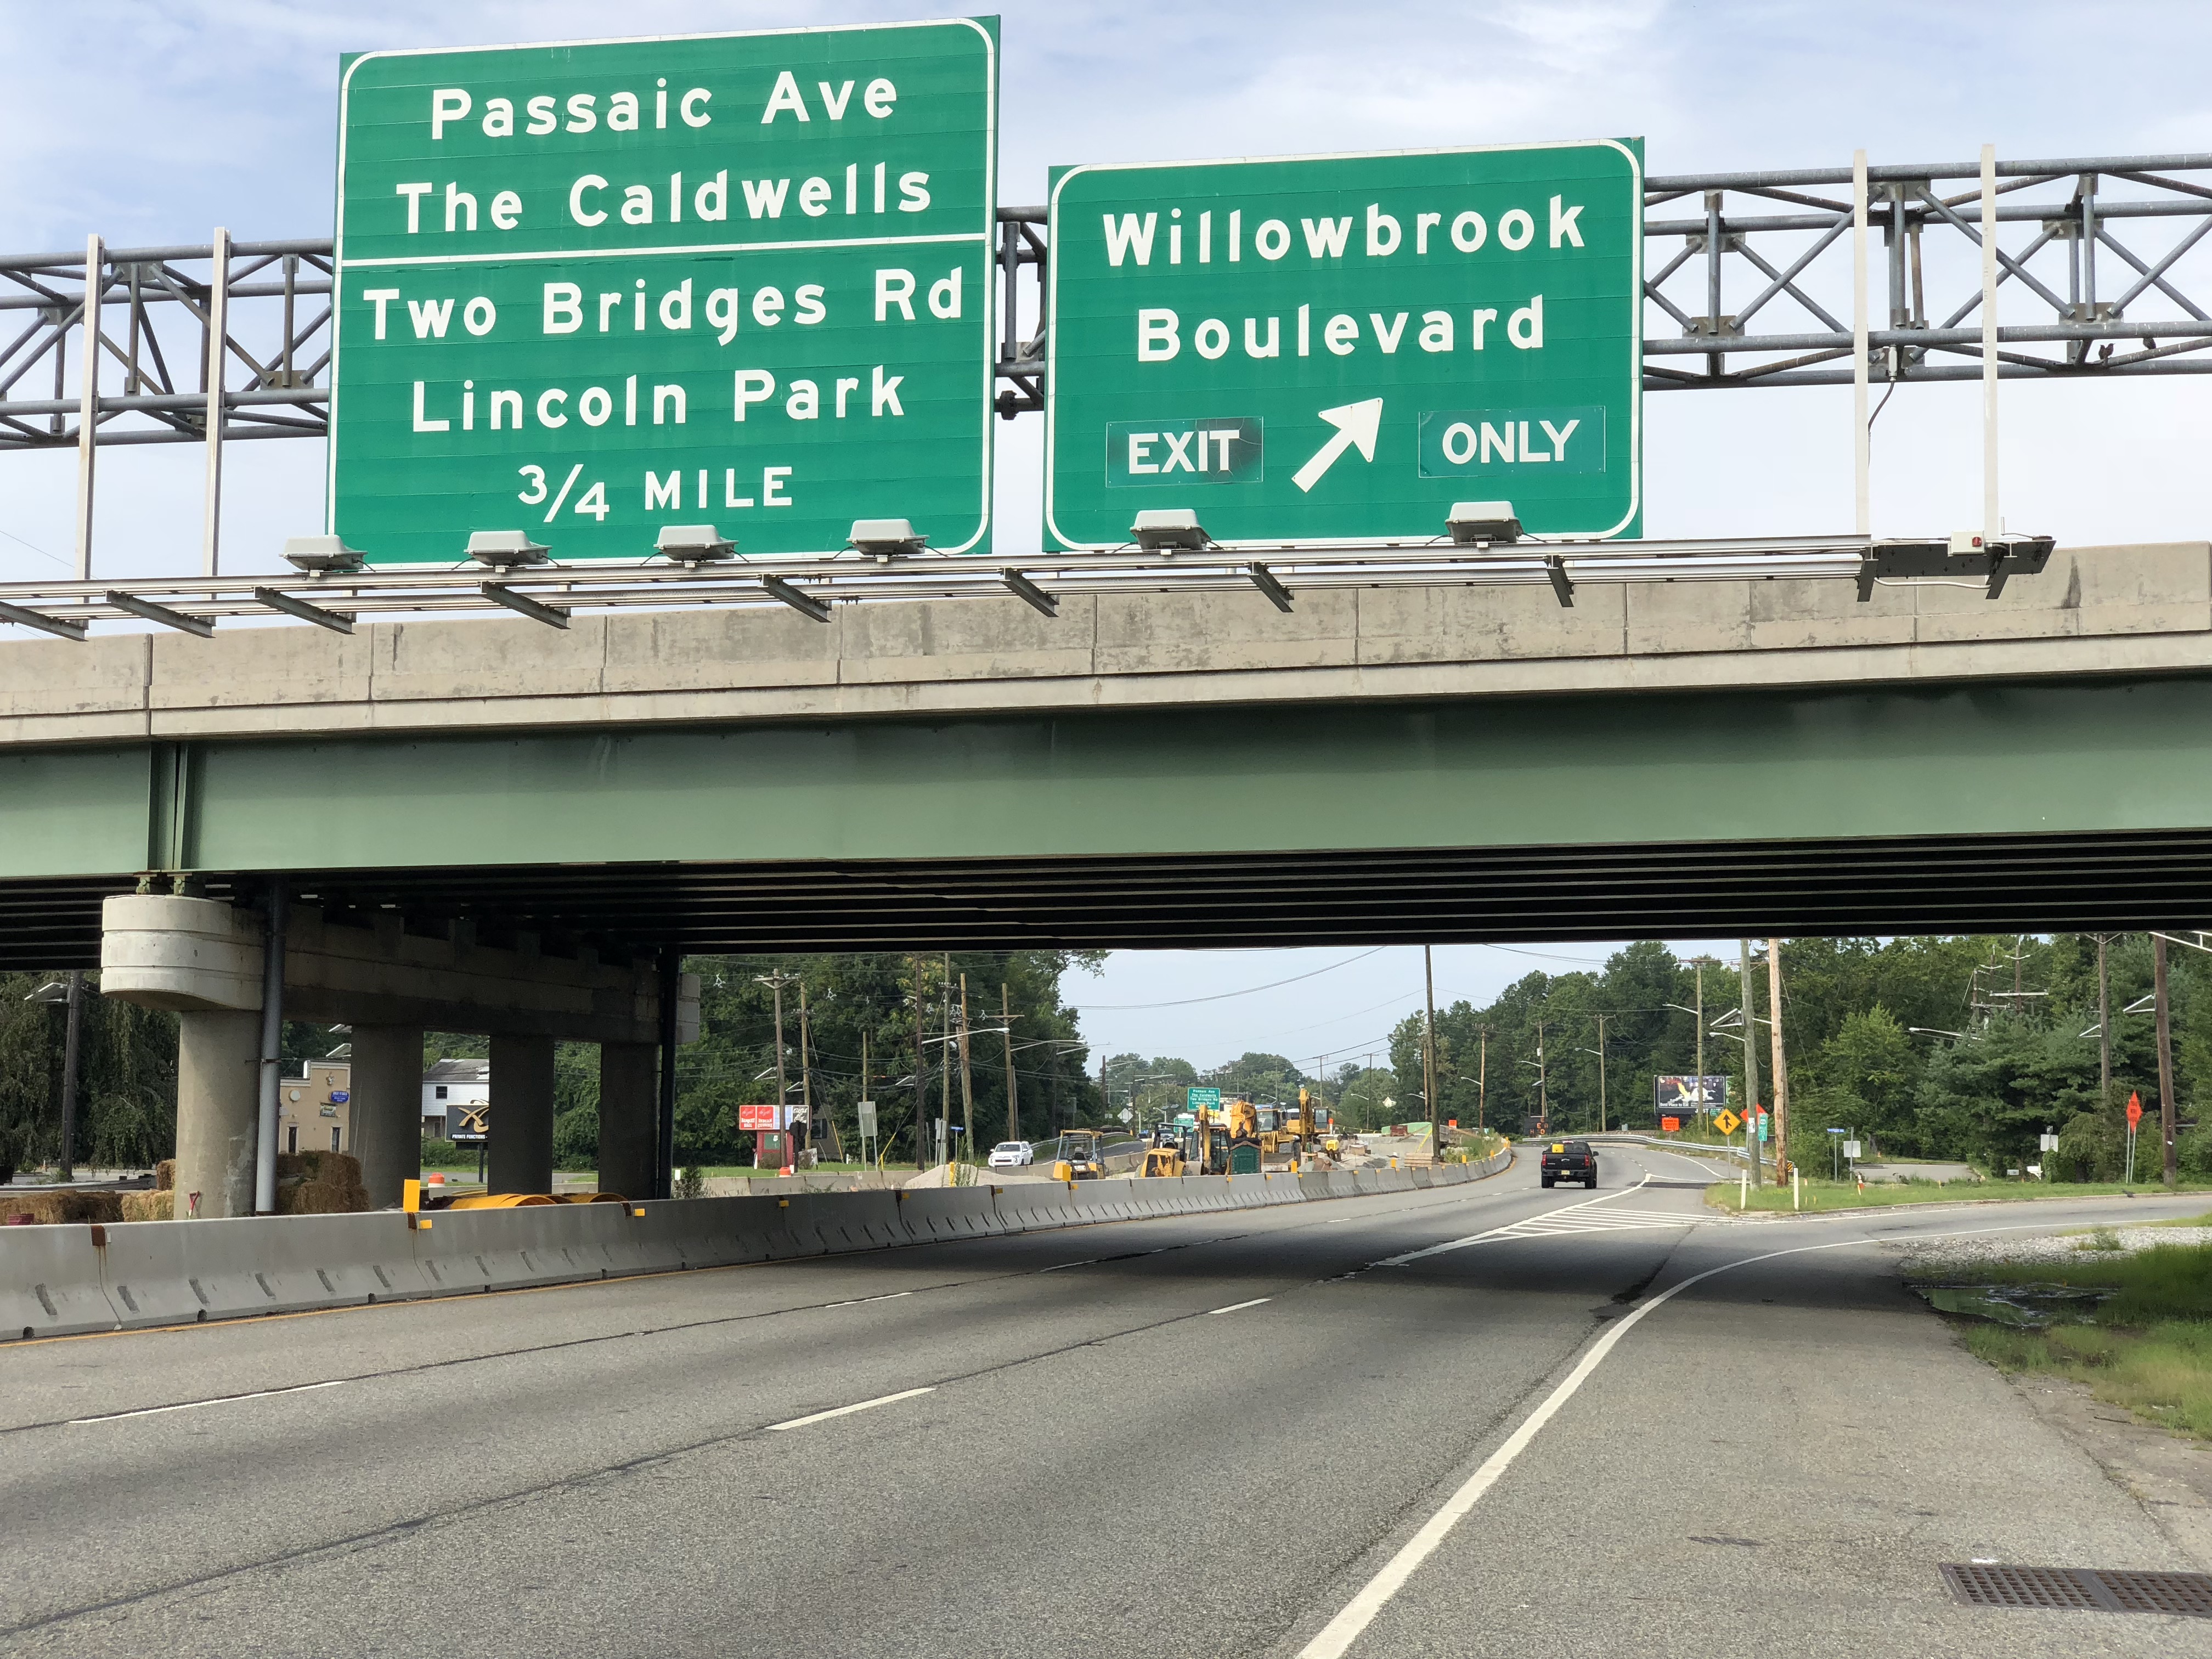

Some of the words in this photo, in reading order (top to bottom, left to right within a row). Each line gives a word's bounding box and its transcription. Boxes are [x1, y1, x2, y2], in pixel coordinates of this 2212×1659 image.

[432, 78, 712, 140] Passaic
[760, 71, 898, 124] Ave
[396, 181, 523, 234] The
[569, 161, 931, 227] Caldwells
[1103, 194, 1585, 267] Willowbrook
[363, 287, 497, 340] Two
[543, 277, 826, 347] Bridges
[874, 266, 962, 321] Rd
[1138, 294, 1544, 362] Boulevard
[413, 374, 686, 432] Lincoln
[734, 364, 905, 422] Park
[1128, 429, 1240, 474] EXIT
[1442, 419, 1580, 464] ONLY
[517, 464, 610, 523] 3/4
[645, 466, 792, 510] MILE
